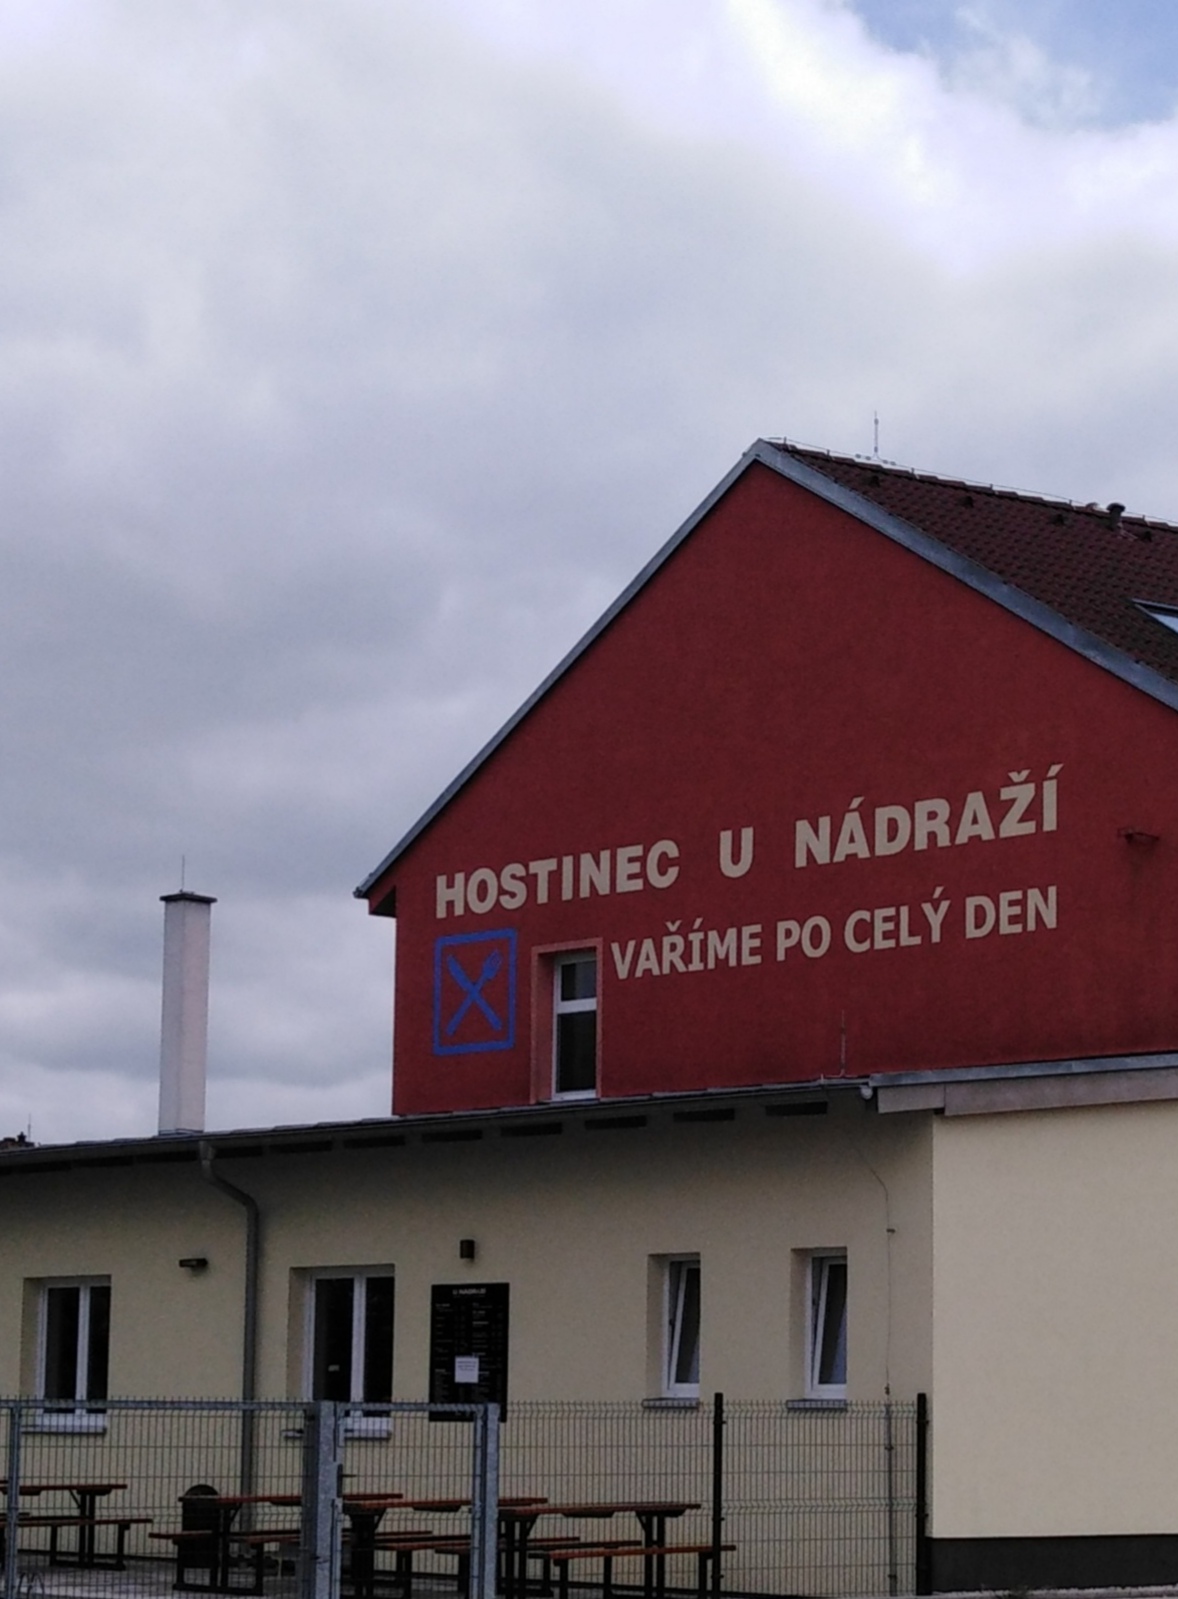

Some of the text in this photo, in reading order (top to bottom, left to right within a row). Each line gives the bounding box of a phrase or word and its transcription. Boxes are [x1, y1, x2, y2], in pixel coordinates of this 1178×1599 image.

[435, 763, 1063, 919] HOSTINEC U NÁDRAŽÍ
[611, 885, 1057, 980] VAŘÍME PO CELÝ DEN
